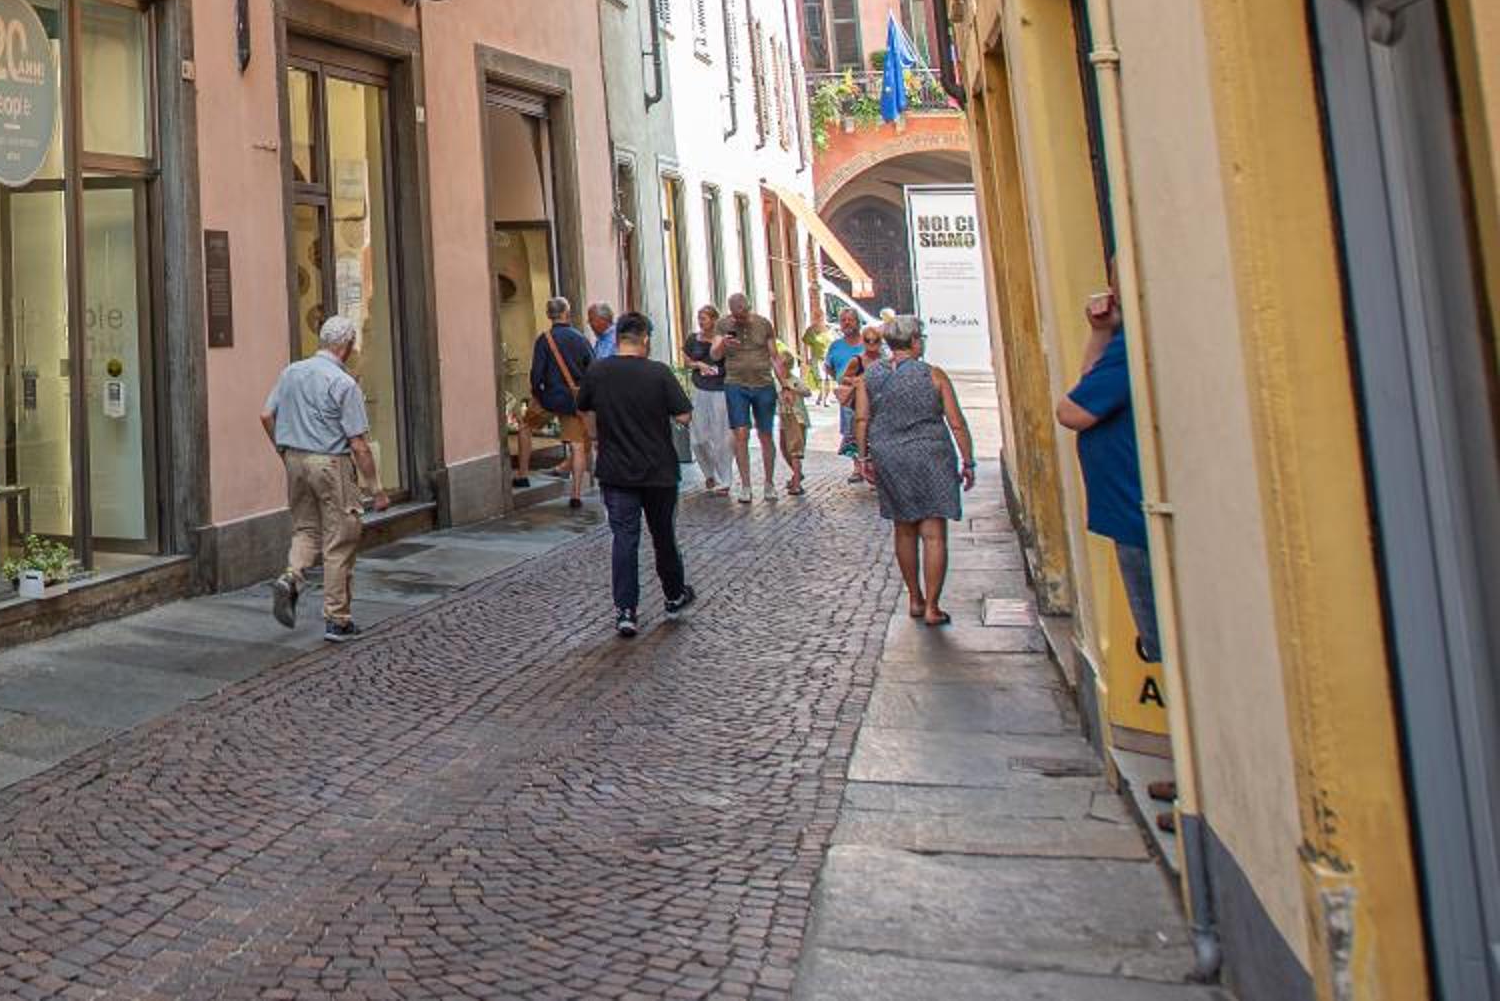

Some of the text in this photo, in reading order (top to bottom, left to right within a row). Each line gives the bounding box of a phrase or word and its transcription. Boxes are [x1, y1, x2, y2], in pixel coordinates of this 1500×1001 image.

[918, 215, 975, 232] NOI CI
[919, 232, 976, 248] SIAMO
